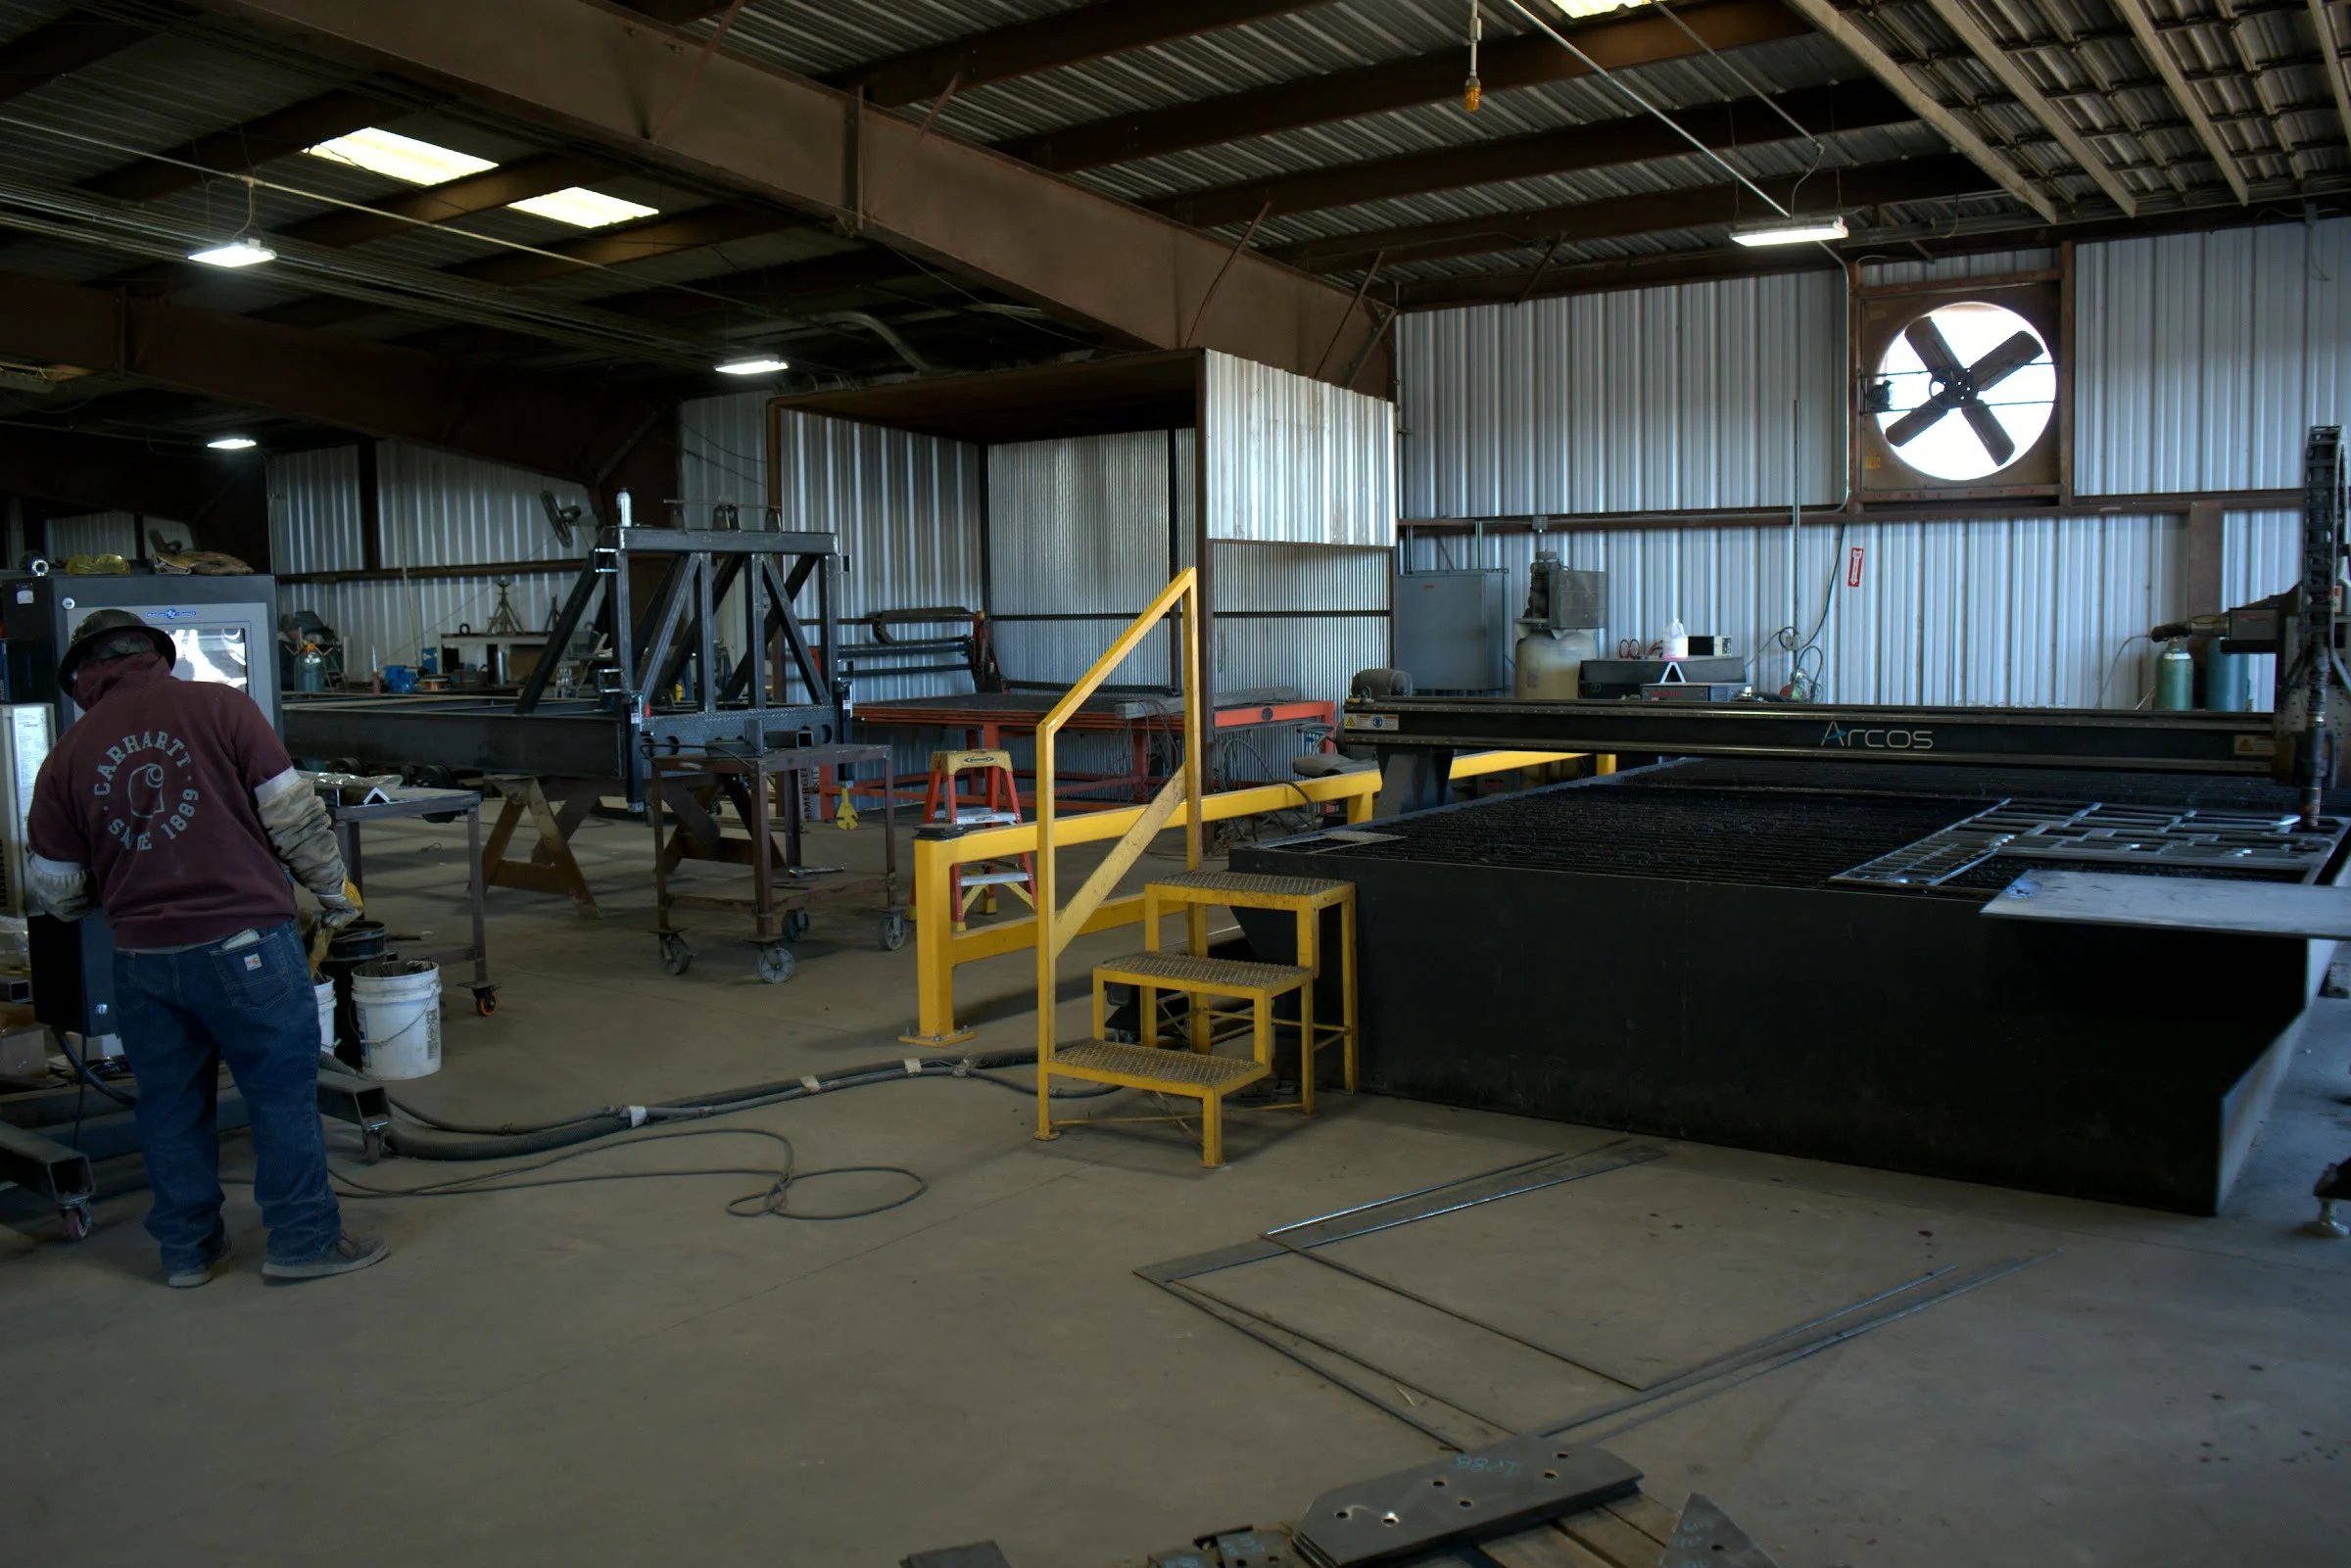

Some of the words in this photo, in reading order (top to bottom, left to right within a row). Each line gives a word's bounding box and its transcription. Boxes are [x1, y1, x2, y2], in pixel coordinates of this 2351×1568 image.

[1820, 720, 1934, 750] Arcos
[94, 731, 192, 796] CARHARTT
[161, 788, 199, 840] 1889
